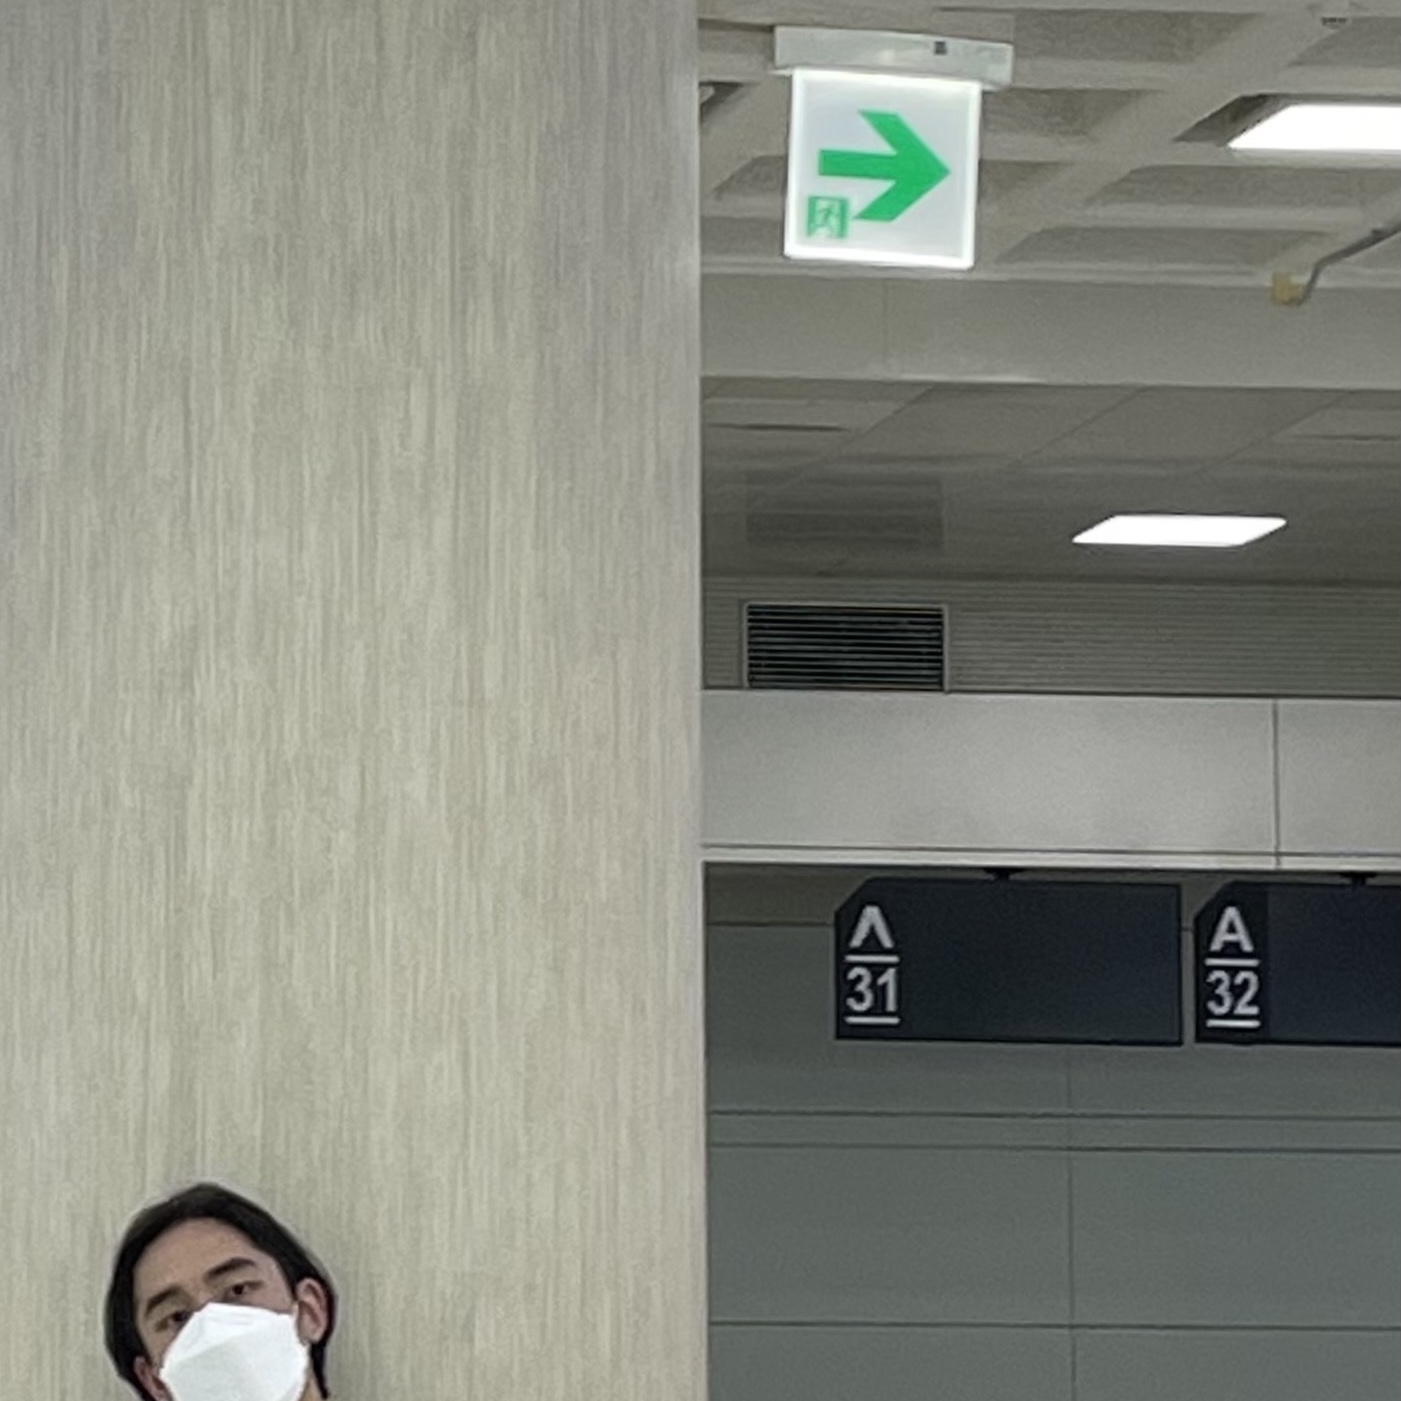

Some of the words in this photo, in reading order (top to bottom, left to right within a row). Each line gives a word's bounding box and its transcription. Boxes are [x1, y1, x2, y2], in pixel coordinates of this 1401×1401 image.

[1210, 906, 1253, 952] A
[846, 967, 897, 1012] 31
[1207, 970, 1259, 1015] 32
